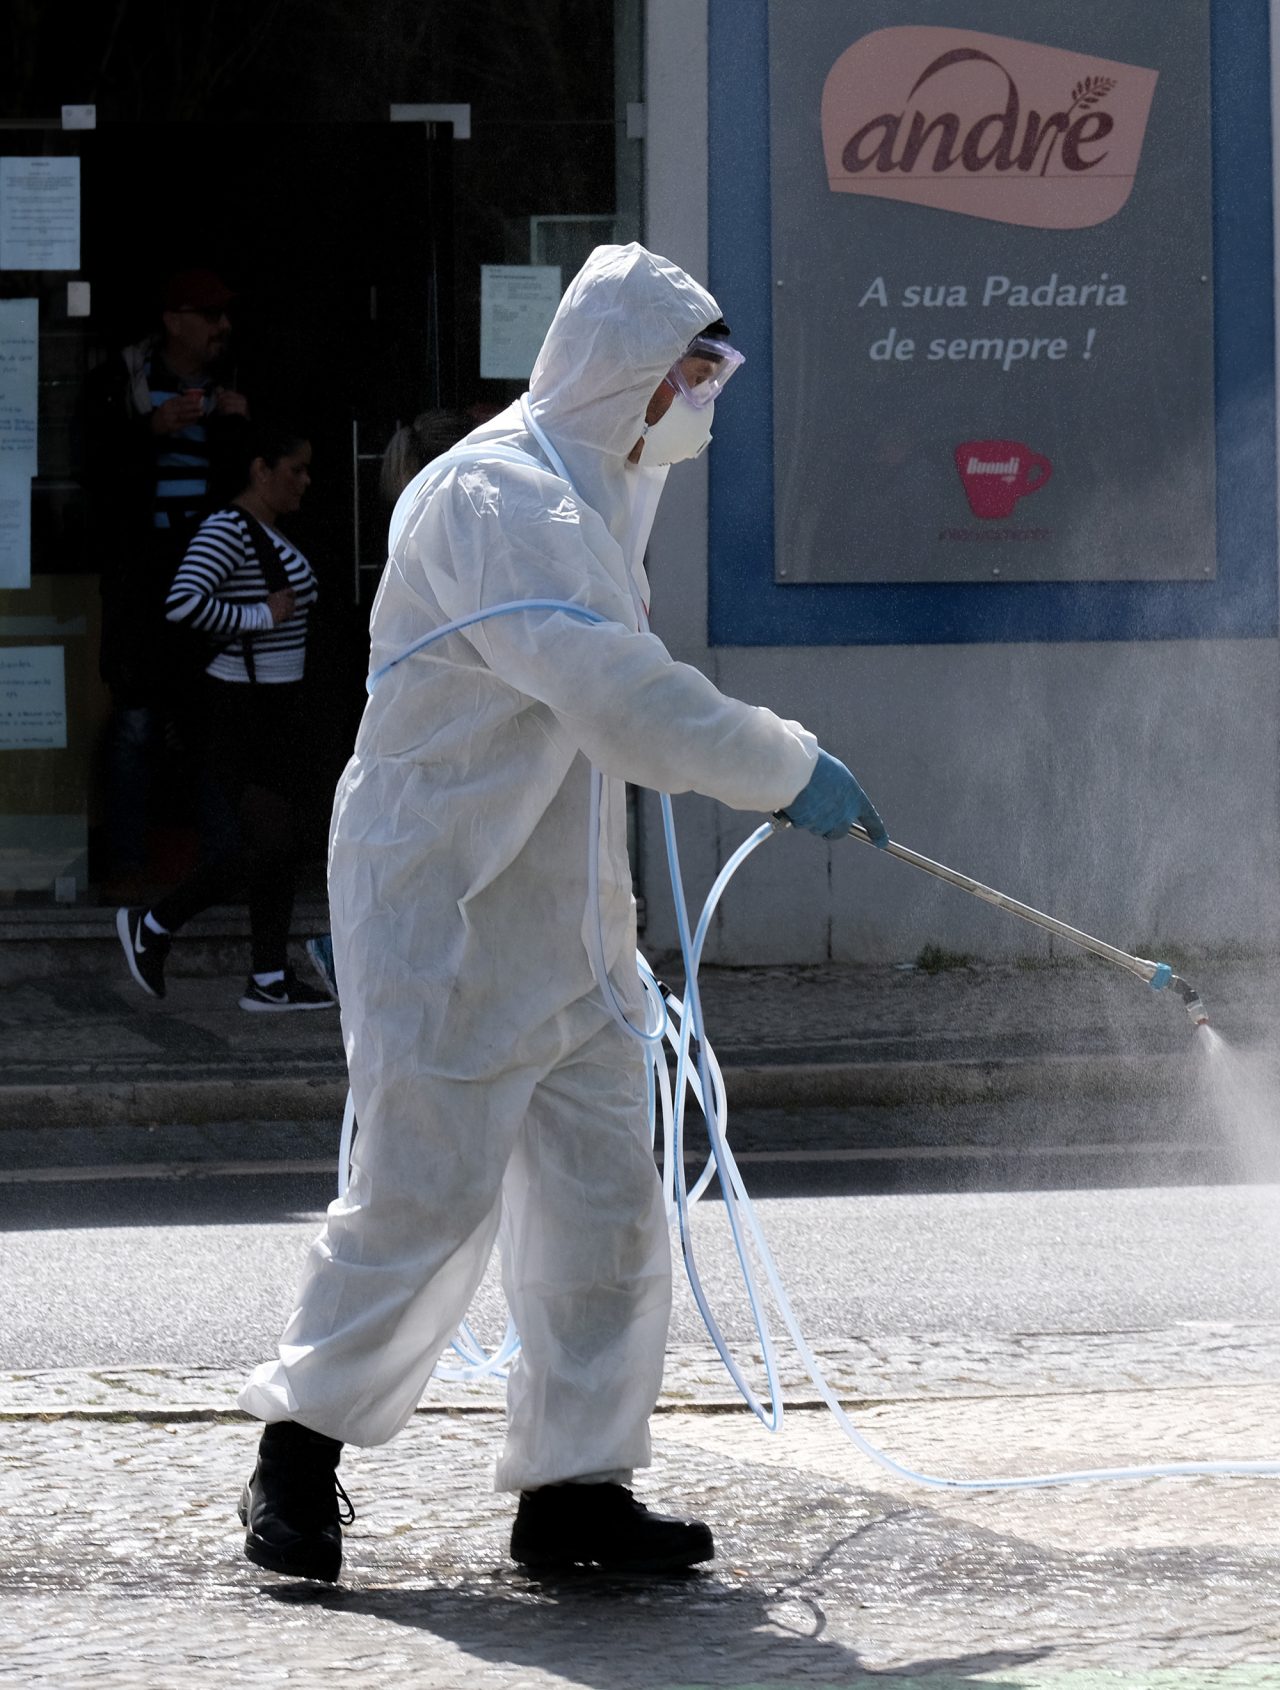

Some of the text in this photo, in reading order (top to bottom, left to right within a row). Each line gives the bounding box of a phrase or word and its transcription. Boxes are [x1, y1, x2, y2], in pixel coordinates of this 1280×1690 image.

[859, 273, 1128, 308] A sua Padaria
[869, 327, 1097, 371] de sempre !
